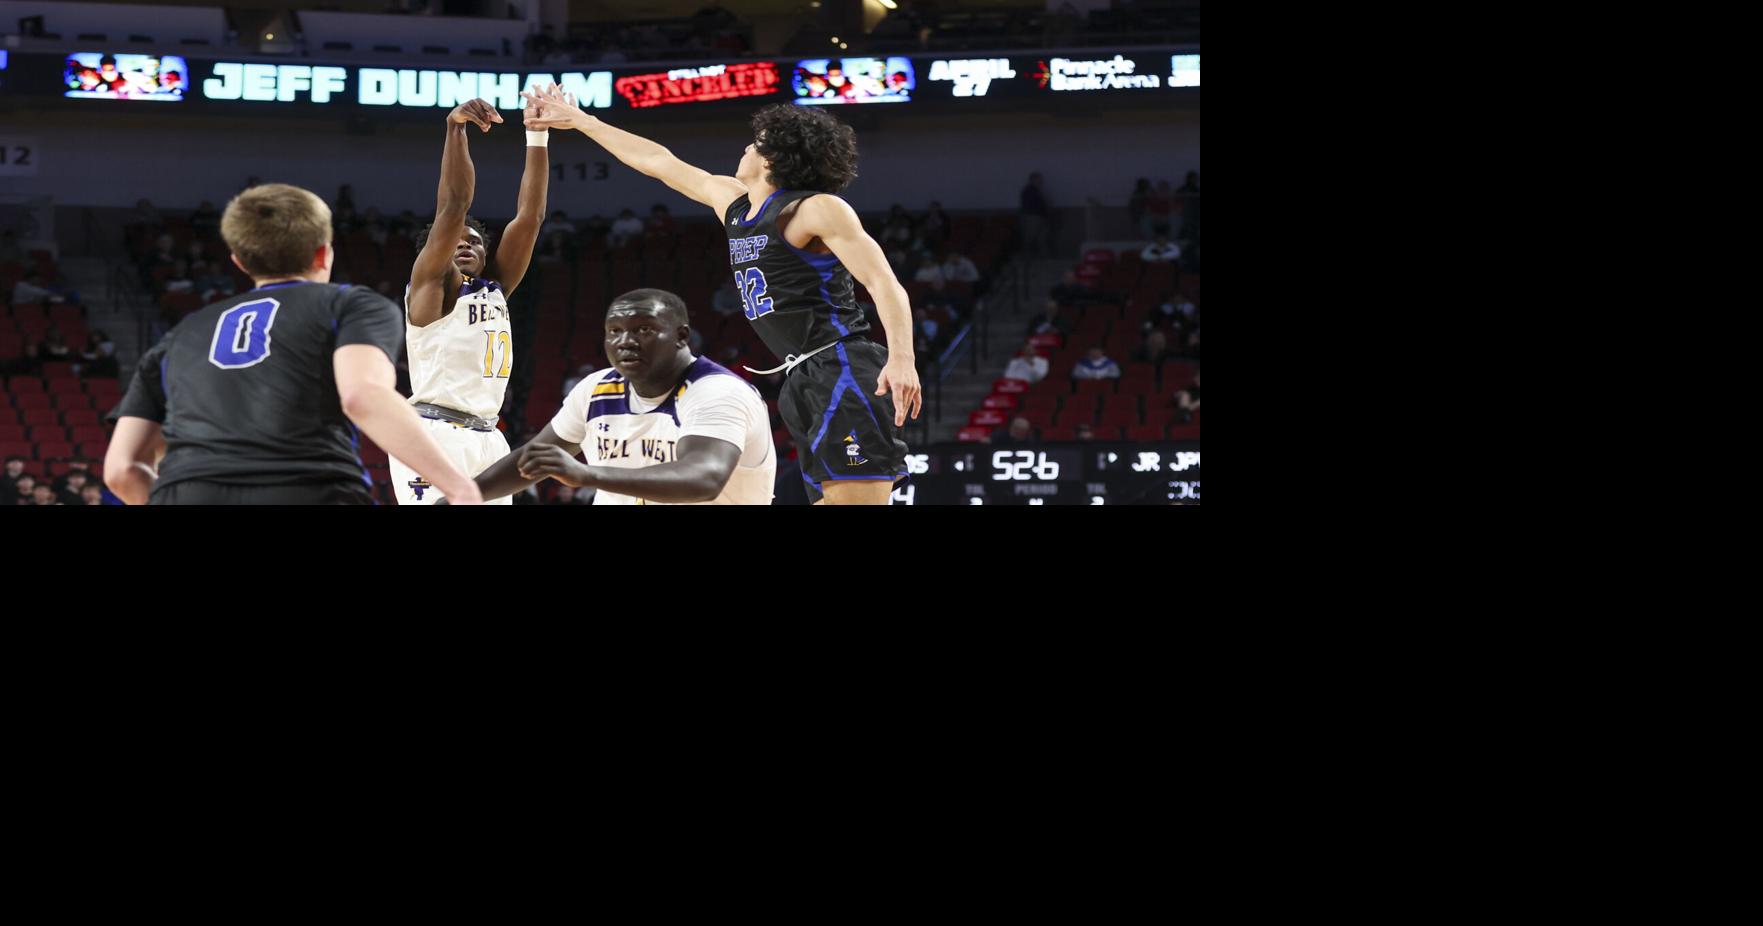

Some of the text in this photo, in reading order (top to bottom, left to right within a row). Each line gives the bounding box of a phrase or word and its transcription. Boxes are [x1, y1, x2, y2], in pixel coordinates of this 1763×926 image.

[929, 58, 1016, 80] APRIL
[1050, 55, 1135, 75] Pinnacle
[203, 62, 613, 109] JEFF DUNHAM
[621, 69, 778, 103] CANCELED
[952, 76, 991, 97] 27
[552, 161, 609, 181] 113
[735, 267, 775, 320] 32
[208, 297, 280, 369] 0
[482, 330, 511, 378] 12
[1131, 451, 1200, 472] JR JP
